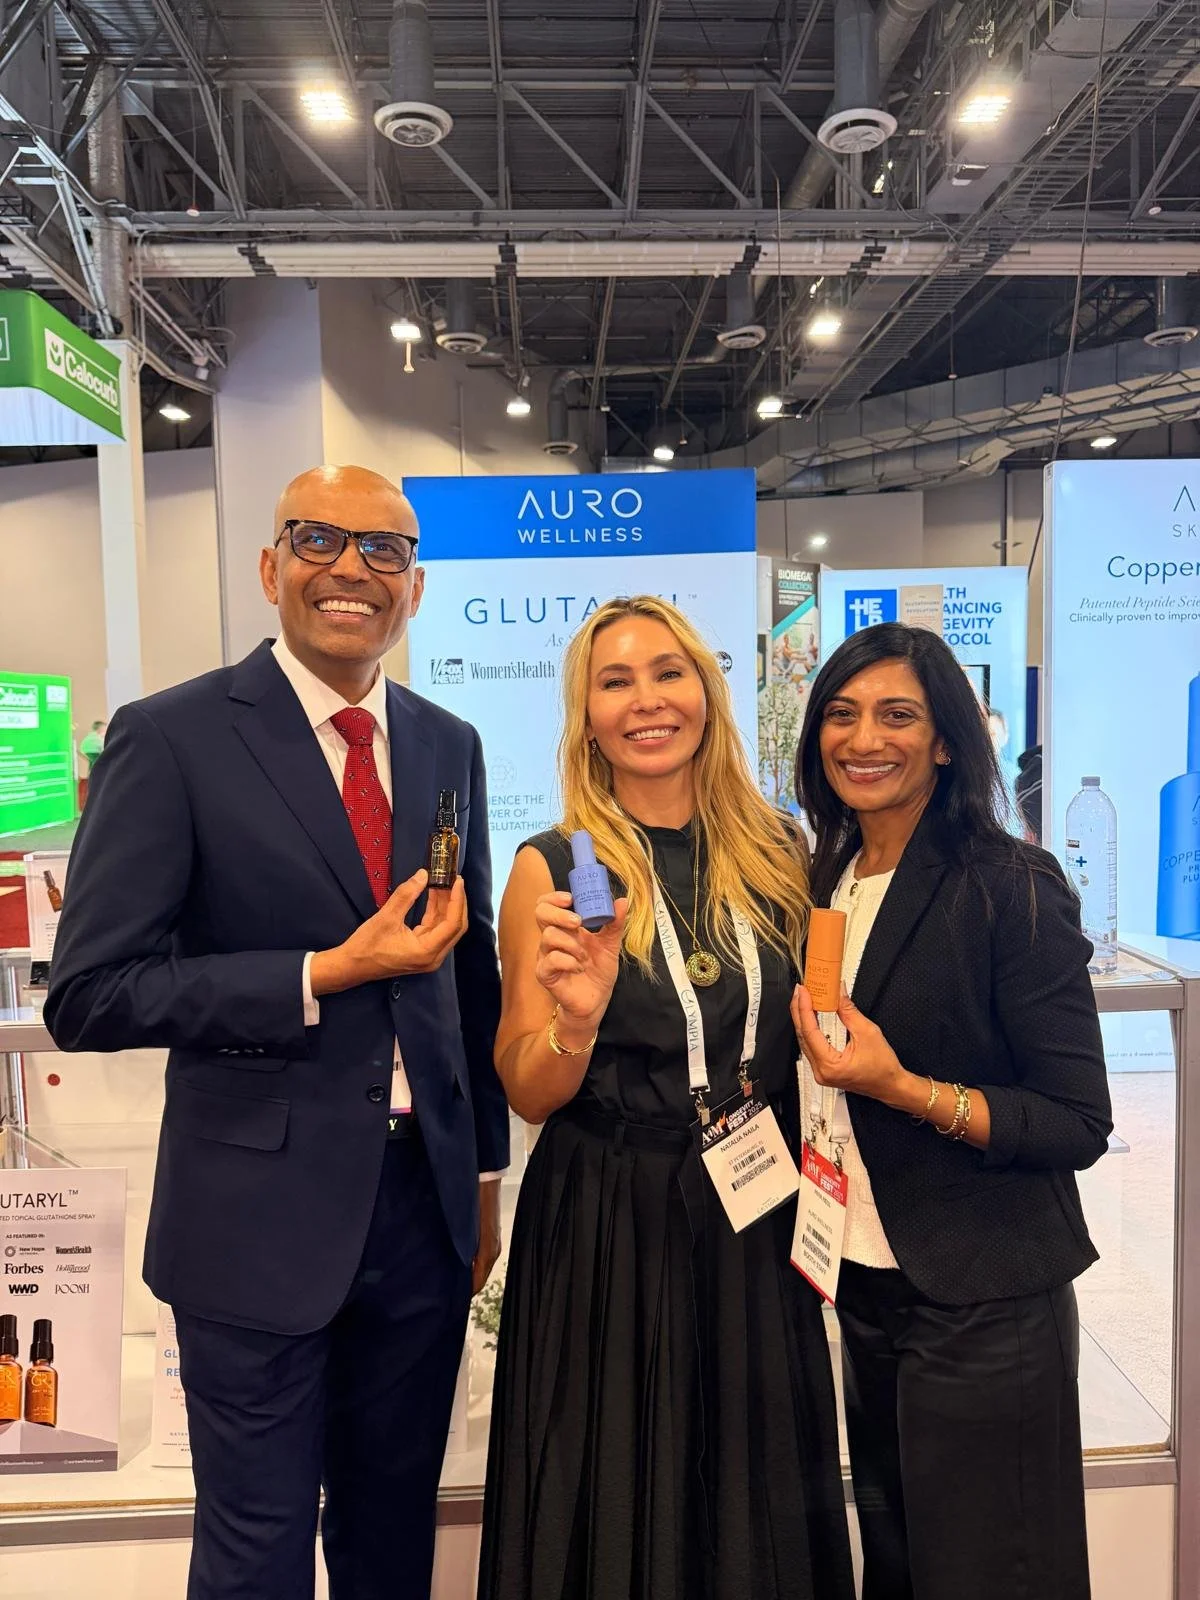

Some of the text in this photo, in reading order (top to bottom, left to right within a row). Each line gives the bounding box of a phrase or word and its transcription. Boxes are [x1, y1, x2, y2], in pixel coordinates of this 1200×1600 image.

[65, 350, 118, 408] Calocurb
[517, 488, 643, 520] AURO
[517, 527, 643, 544] WELLNESS
[944, 587, 966, 599] TH
[1080, 595, 1130, 609] Patented
[1133, 596, 1176, 611] Peptide
[1069, 612, 1113, 624] Clinically
[1116, 615, 1152, 623] proven
[1154, 612, 1166, 621] to
[523, 795, 544, 804] THE
[514, 808, 529, 817] OF
[679, 989, 700, 1053] OLYMPIA
[726, 1101, 755, 1122] LONGEVITY
[726, 1101, 764, 1132] FEST 2025
[720, 1132, 744, 1153] NATALIA
[5, 1264, 44, 1274] Forbes
[9, 1285, 39, 1294] WWD
[55, 1284, 90, 1294] POOSH
